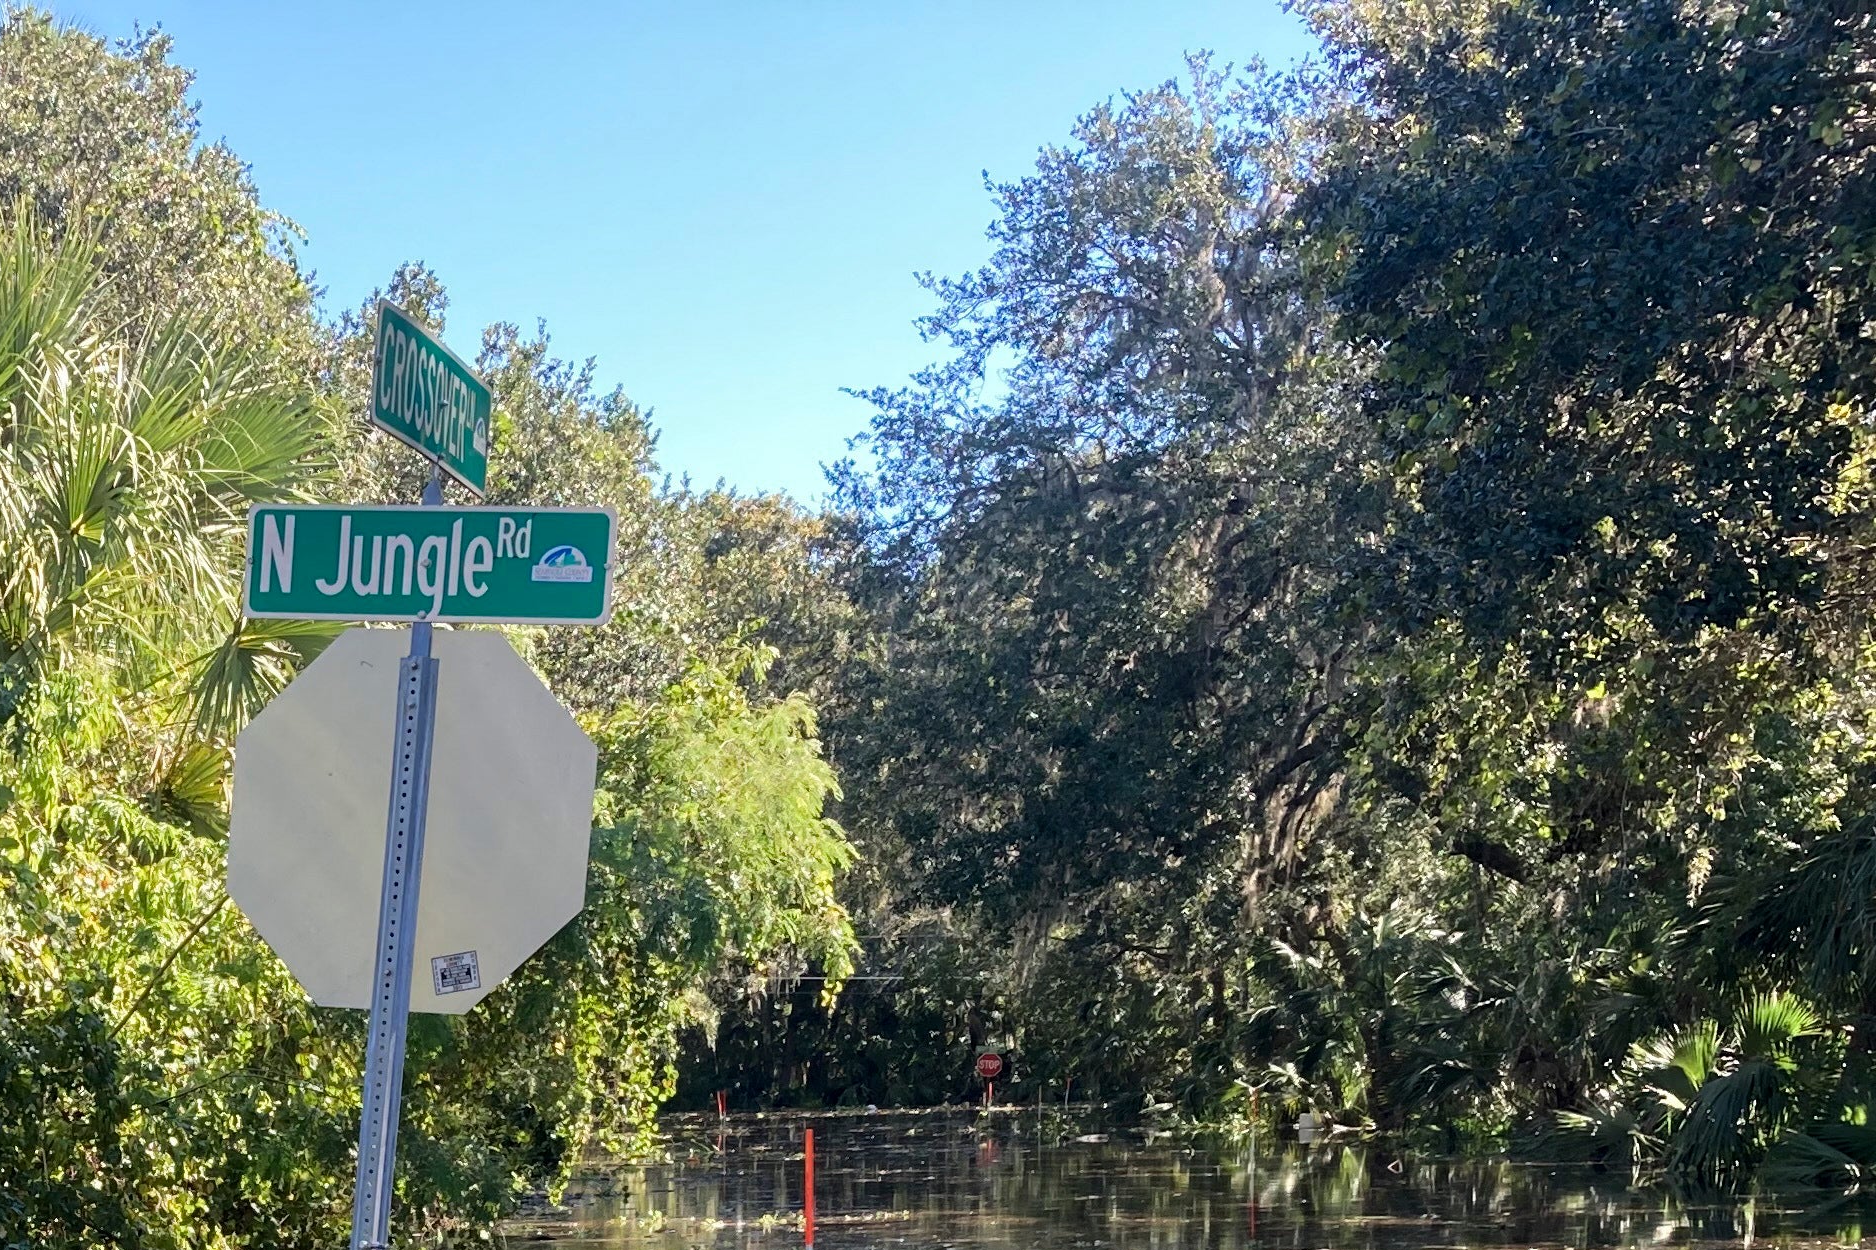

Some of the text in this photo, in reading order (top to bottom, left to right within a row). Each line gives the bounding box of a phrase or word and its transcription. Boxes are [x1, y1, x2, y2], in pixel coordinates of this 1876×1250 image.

[380, 322, 468, 463] CROSSOVER
[259, 514, 532, 616] N Jungle Rd
[979, 1060, 1000, 1069] STOP
